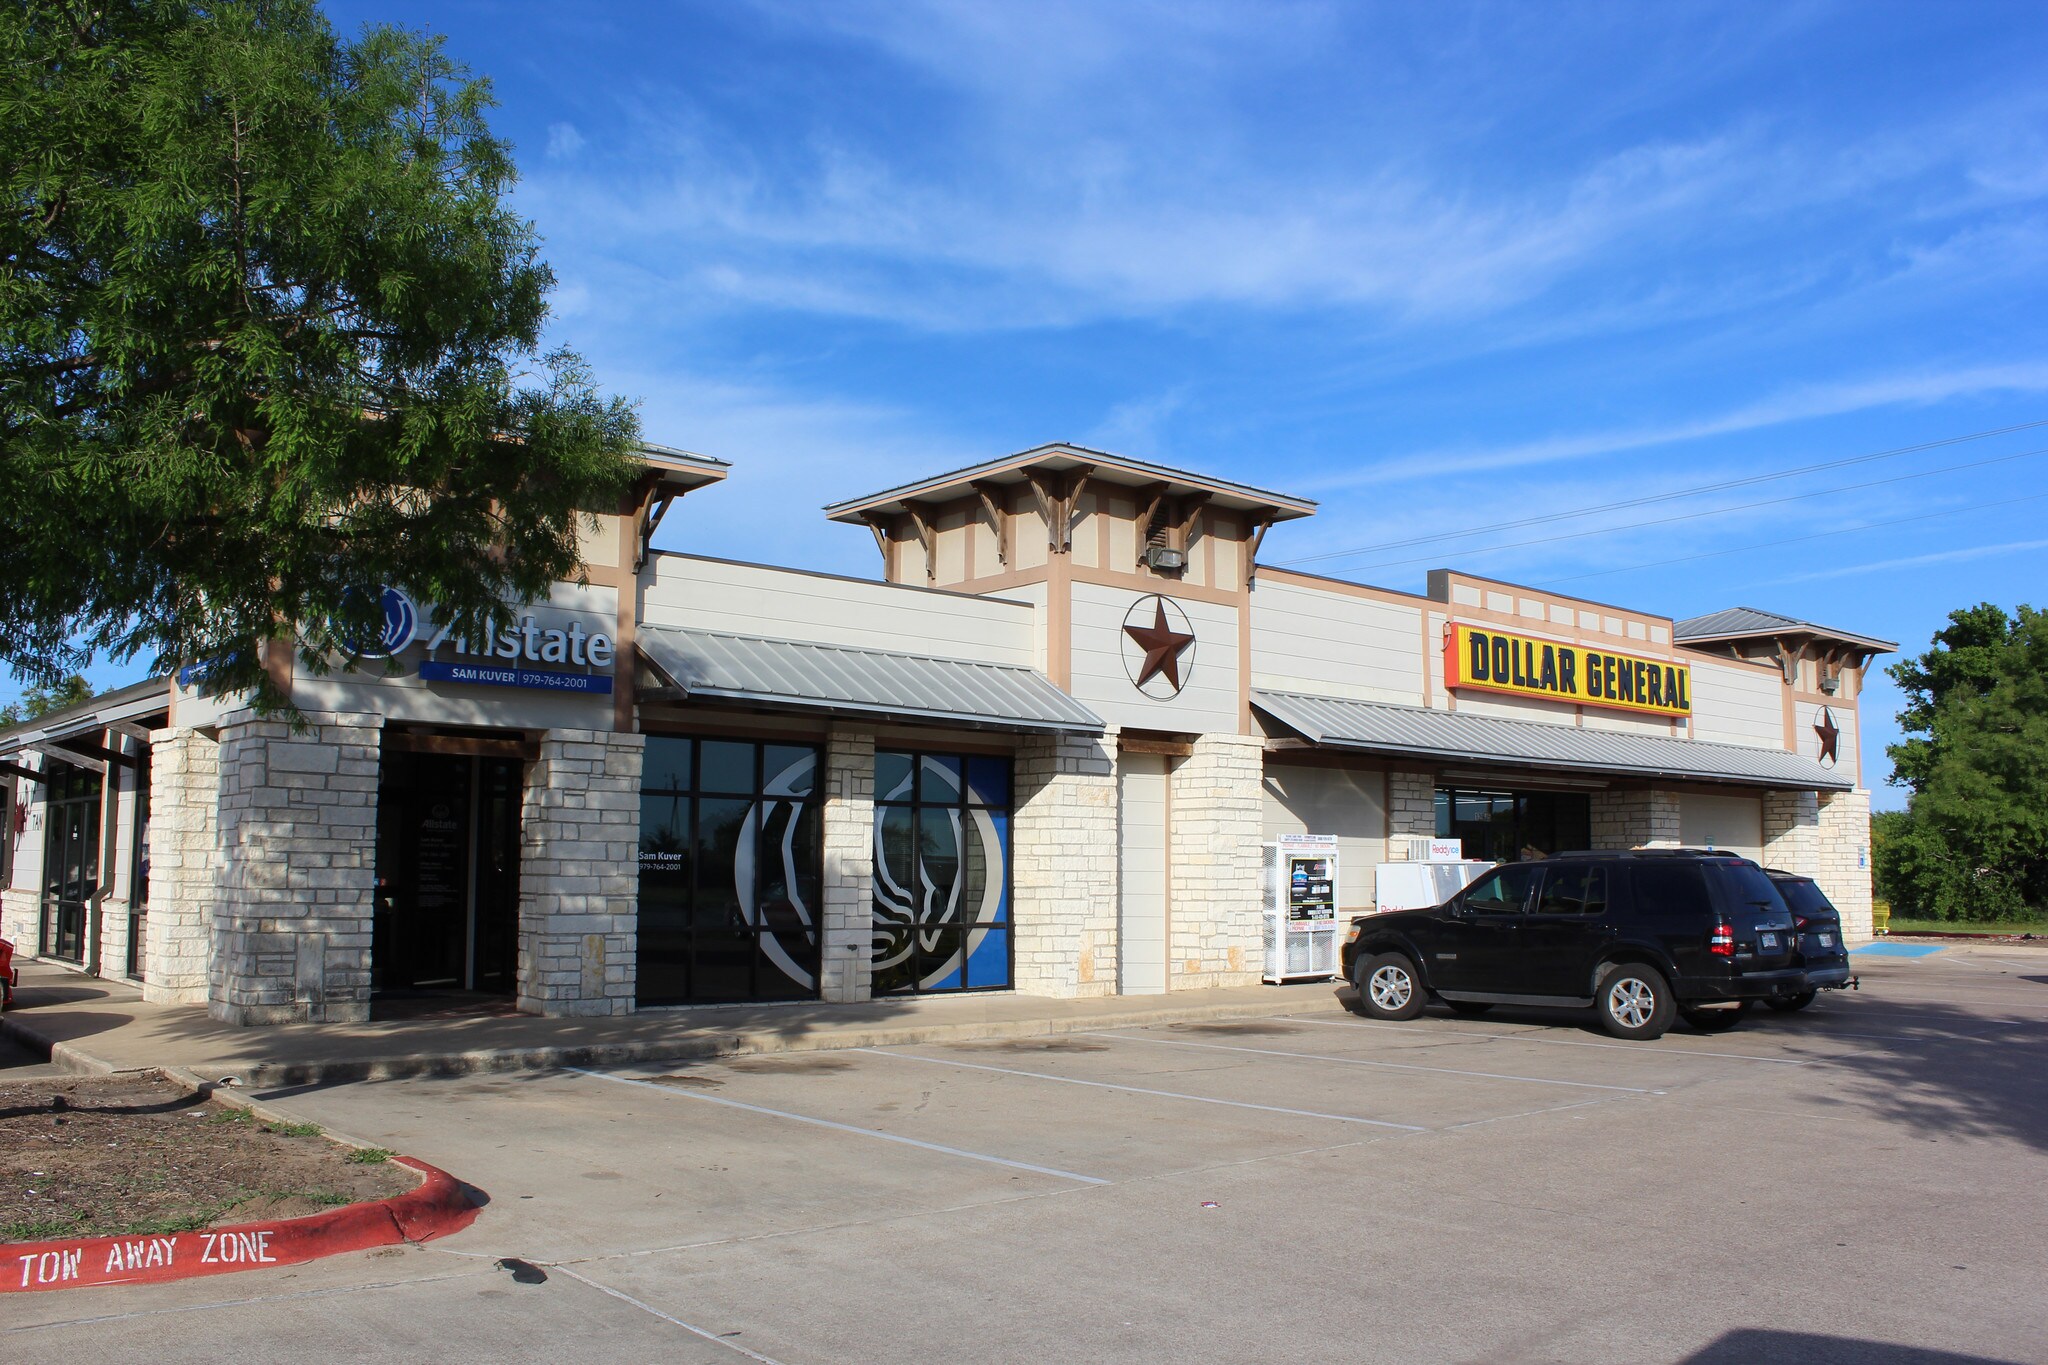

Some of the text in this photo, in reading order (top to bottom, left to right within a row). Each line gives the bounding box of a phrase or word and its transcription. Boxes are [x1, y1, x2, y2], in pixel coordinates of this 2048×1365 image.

[452, 668, 587, 688] SAM KUVER 979-764-2001
[1469, 631, 1690, 710] DOLLAR GENERAL
[639, 851, 682, 860] Sam Kuver
[19, 1231, 277, 1287] TOW AWAY ZONE
